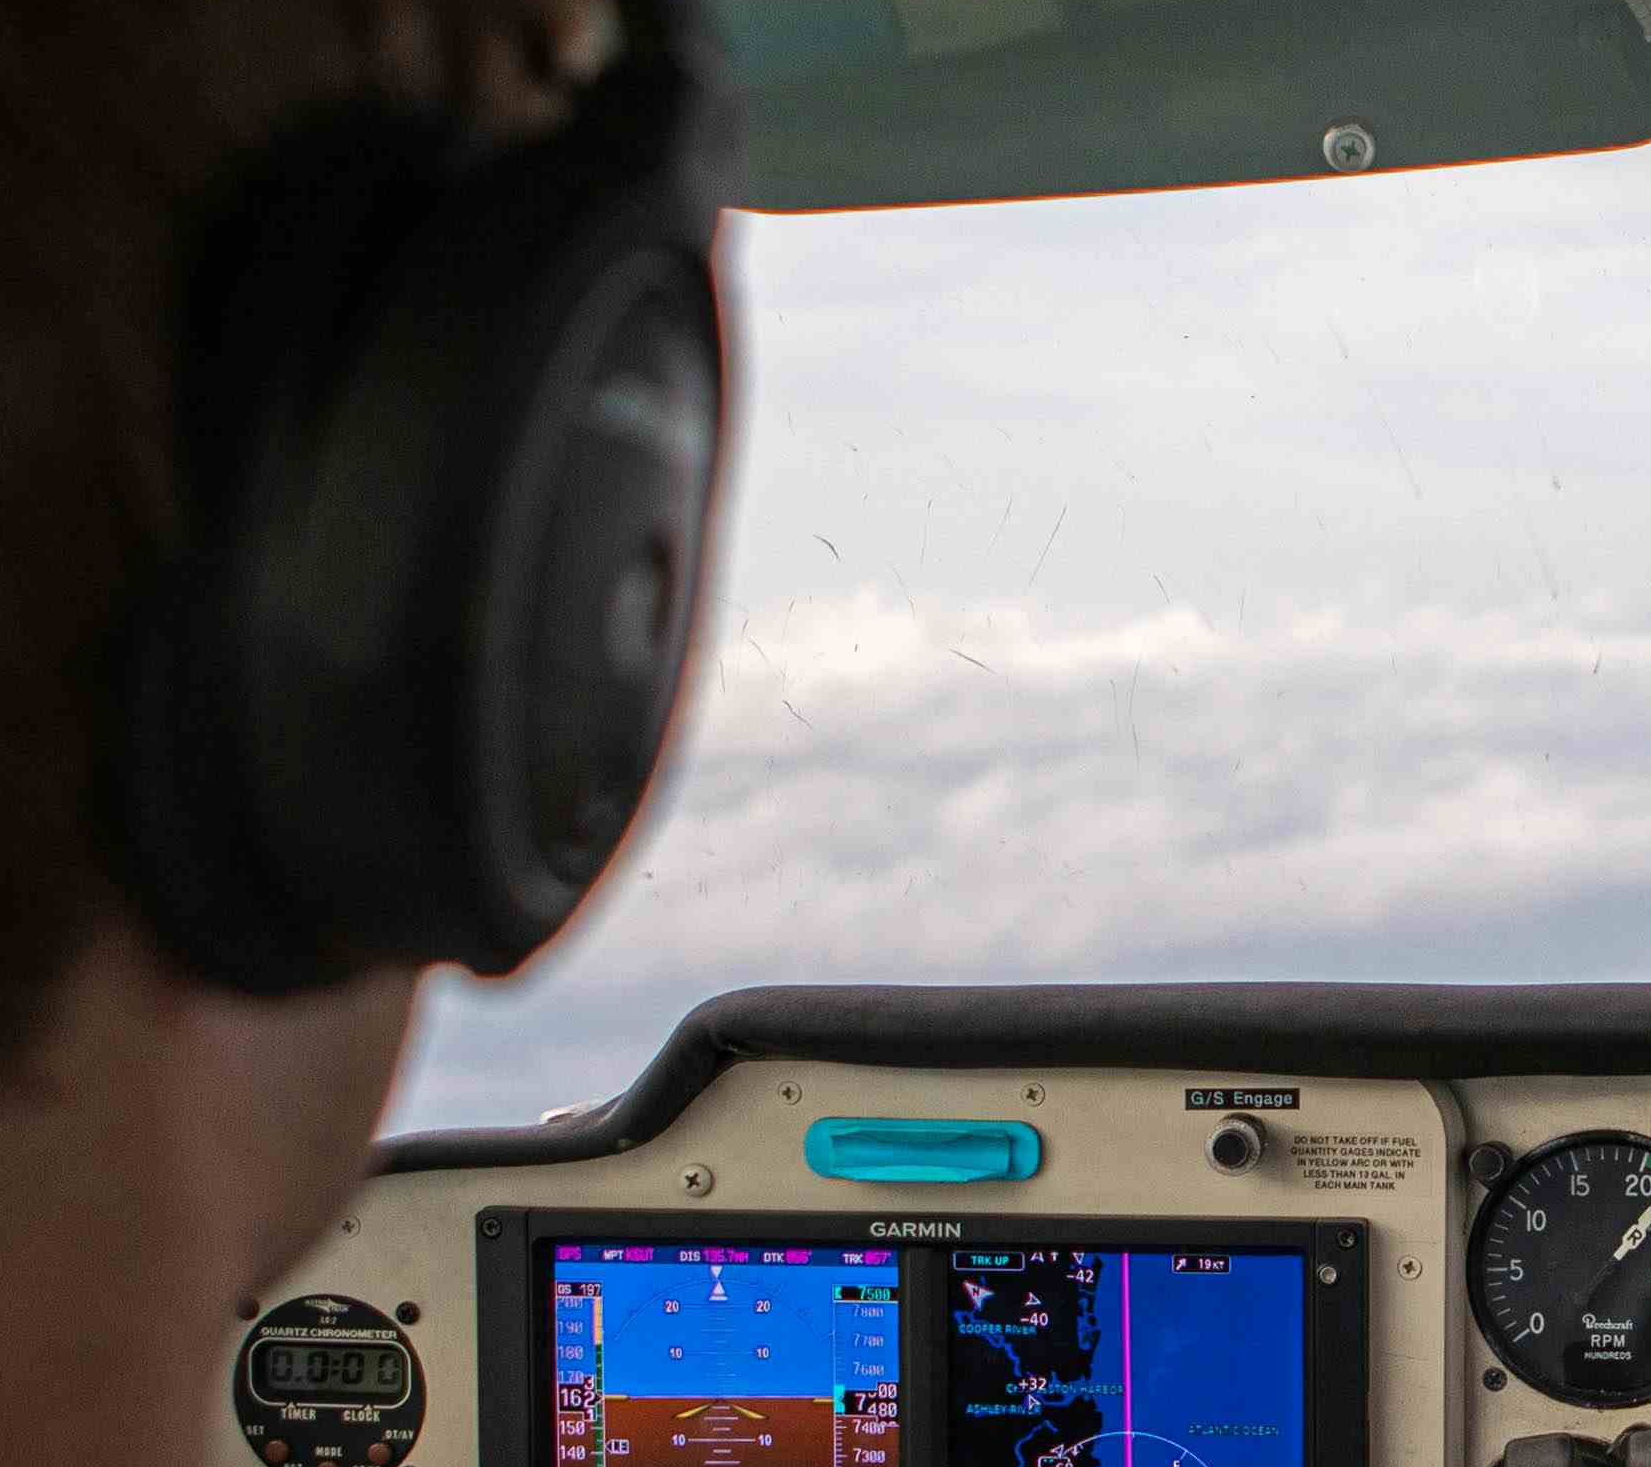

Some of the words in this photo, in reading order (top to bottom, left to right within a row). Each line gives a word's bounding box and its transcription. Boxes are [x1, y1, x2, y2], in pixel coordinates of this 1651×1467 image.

[1191, 1092, 1224, 1104] G/S
[1234, 1092, 1293, 1106] Engage
[1295, 1137, 1307, 1145] DO
[1310, 1137, 1329, 1145] NOT
[1333, 1137, 1357, 1145] TAKE
[1360, 1137, 1378, 1146] OFF
[1381, 1138, 1389, 1146] IF
[1392, 1138, 1417, 1146] FUEL
[1291, 1147, 1337, 1156] QUANTITY
[1341, 1148, 1373, 1156] GAGES
[1376, 1148, 1421, 1158] INDICATE
[1309, 1159, 1348, 1167] YELLOW
[1351, 1159, 1369, 1167] ARC
[1373, 1160, 1387, 1168] OR
[1390, 1160, 1413, 1168] WITH
[1303, 1170, 1327, 1178] LESS
[1331, 1170, 1355, 1178] THAN
[1395, 1172, 1405, 1180] IN
[1343, 1182, 1367, 1190] MAIN
[1370, 1182, 1395, 1190] TANK
[1571, 1175, 1589, 1196] 15
[1527, 1210, 1546, 1231] 10
[870, 1222, 961, 1237] GARMIN
[971, 1256, 991, 1265] TRK
[994, 1256, 1009, 1265] UP
[261, 1328, 308, 1337] QUARTZ
[311, 1329, 397, 1339] CHRONOMETER
[959, 1324, 1002, 1334] COOPER
[1006, 1325, 1037, 1334] RIVER
[1591, 1335, 1625, 1347] RPM
[1584, 1352, 1632, 1360] HUNDREDS
[281, 1409, 316, 1419] TIMER
[344, 1411, 380, 1421] CLOCK
